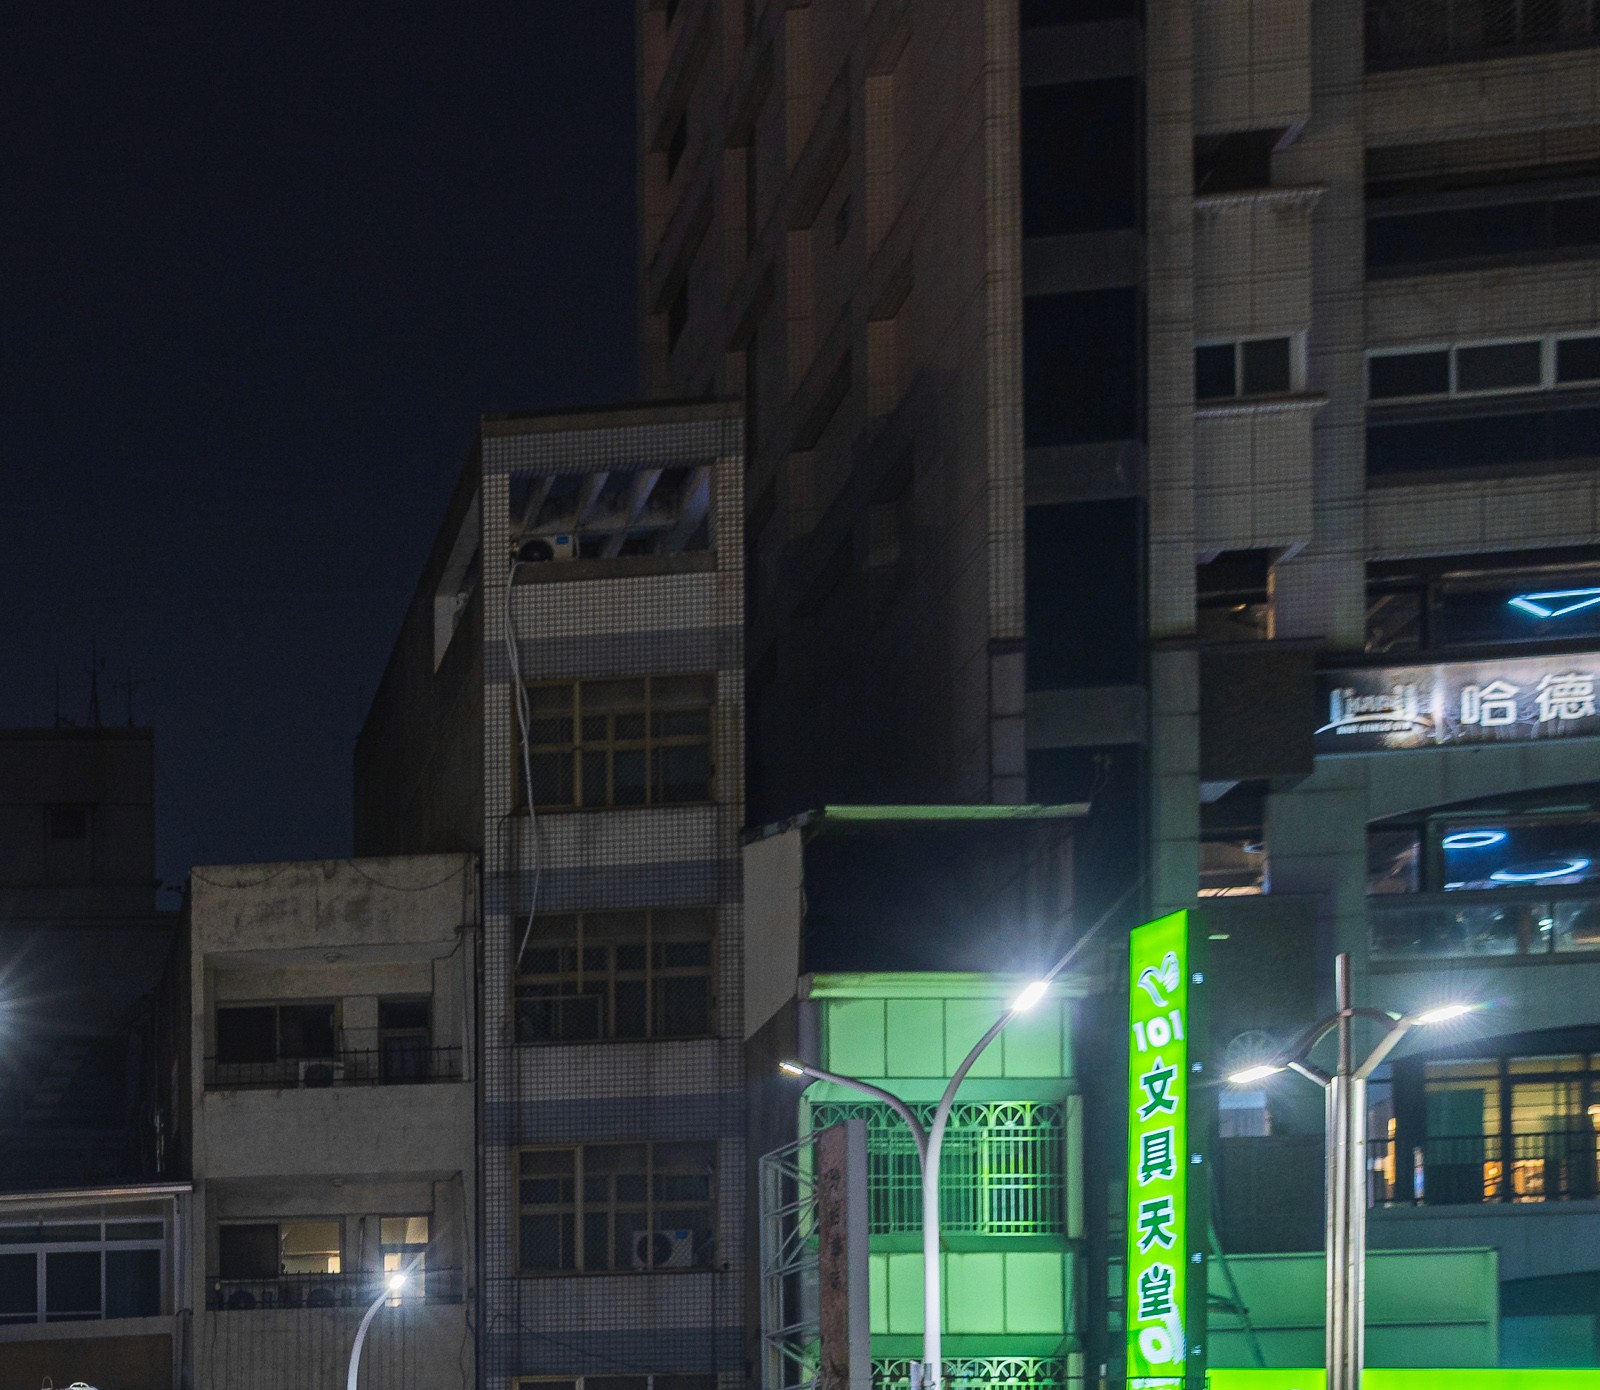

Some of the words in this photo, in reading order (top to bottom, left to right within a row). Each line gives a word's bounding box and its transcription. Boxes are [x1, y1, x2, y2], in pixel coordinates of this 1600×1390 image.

[1132, 1009, 1185, 1052] 101
[1135, 1055, 1180, 1322] 文具天堂
